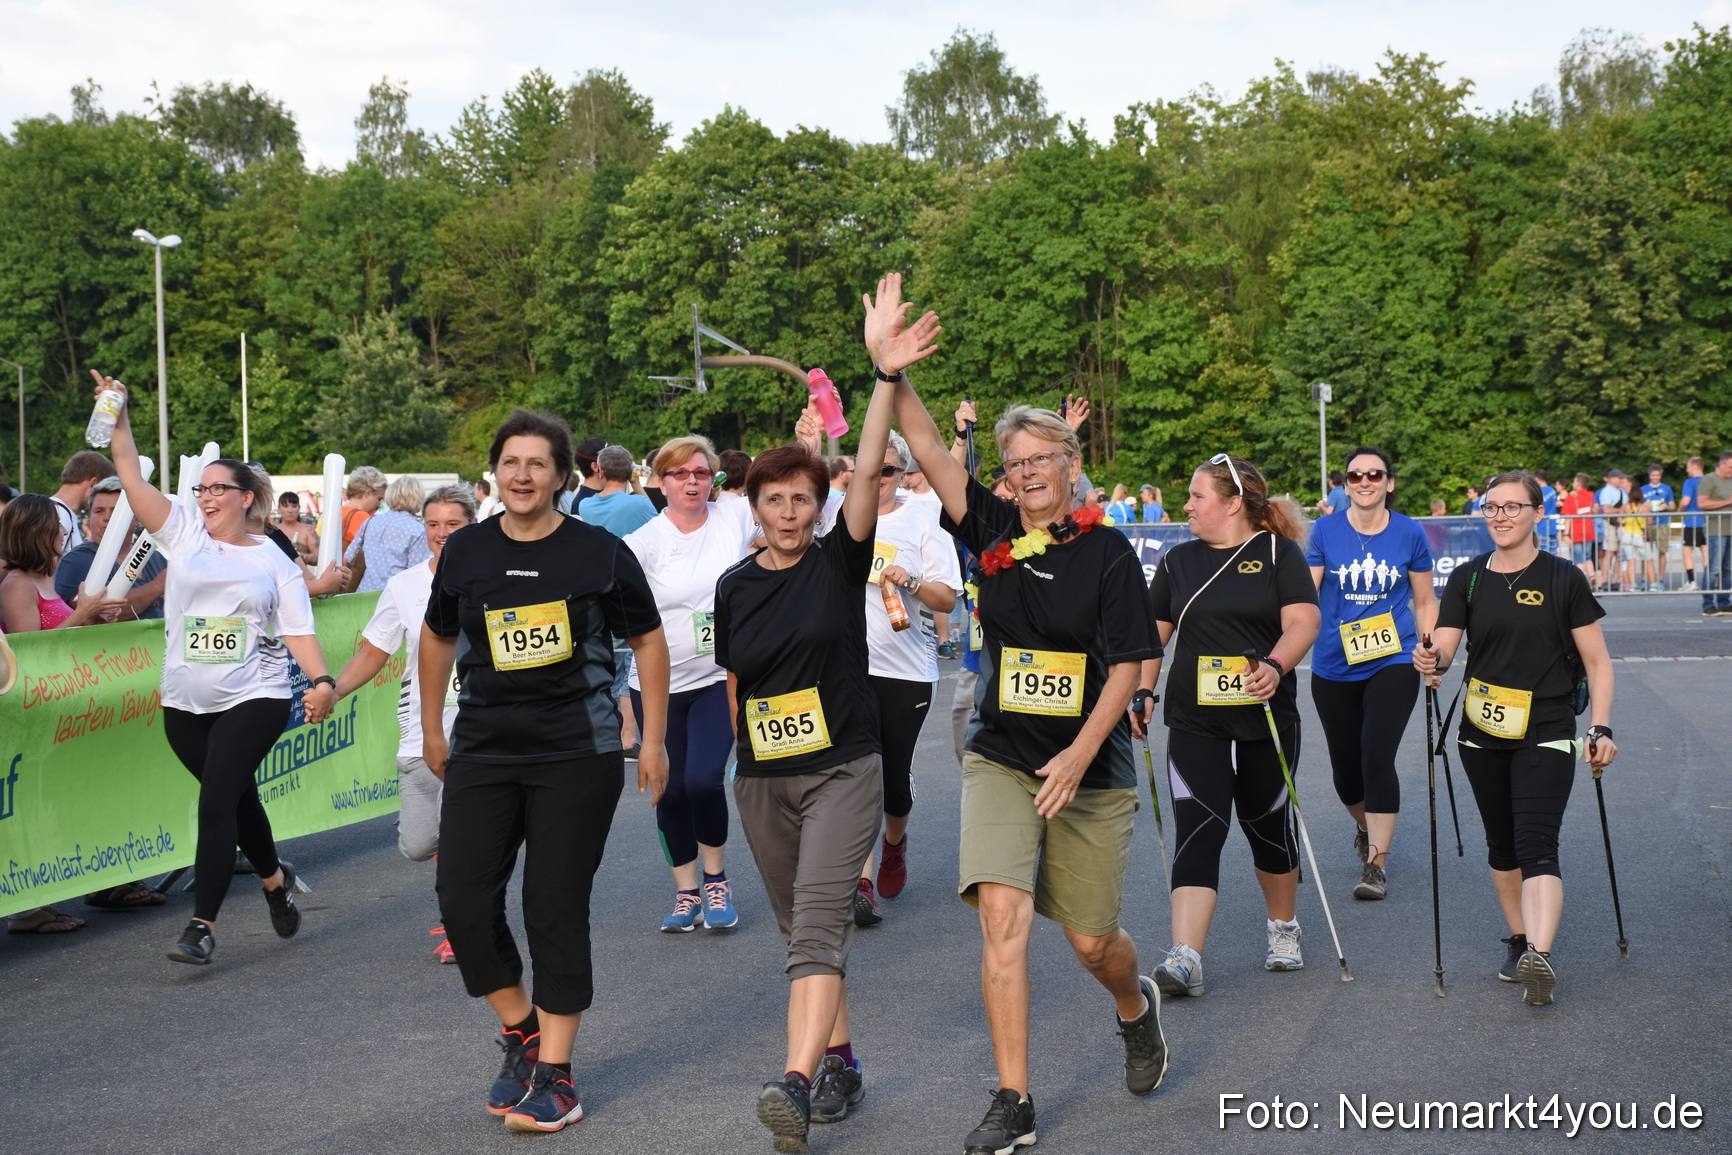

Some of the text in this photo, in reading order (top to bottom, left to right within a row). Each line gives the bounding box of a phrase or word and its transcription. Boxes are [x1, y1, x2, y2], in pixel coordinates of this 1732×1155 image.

[874, 557, 885, 571] 0
[1432, 556, 1470, 574] er
[190, 633, 236, 650] 2166
[500, 625, 560, 653] 1954
[701, 627, 715, 642] 2
[1350, 629, 1391, 651] 1716
[528, 648, 551, 657] Kerstin
[23, 646, 157, 709] Gesunde Firmen
[1010, 671, 1072, 698] 1958
[1217, 674, 1243, 691] 64
[1013, 695, 1042, 703] Eichinger
[53, 697, 115, 744] laufen
[1482, 702, 1505, 723] 55
[757, 712, 814, 742] 1965
[0, 824, 175, 897] w.firmenlauf-oberpfalz.de
